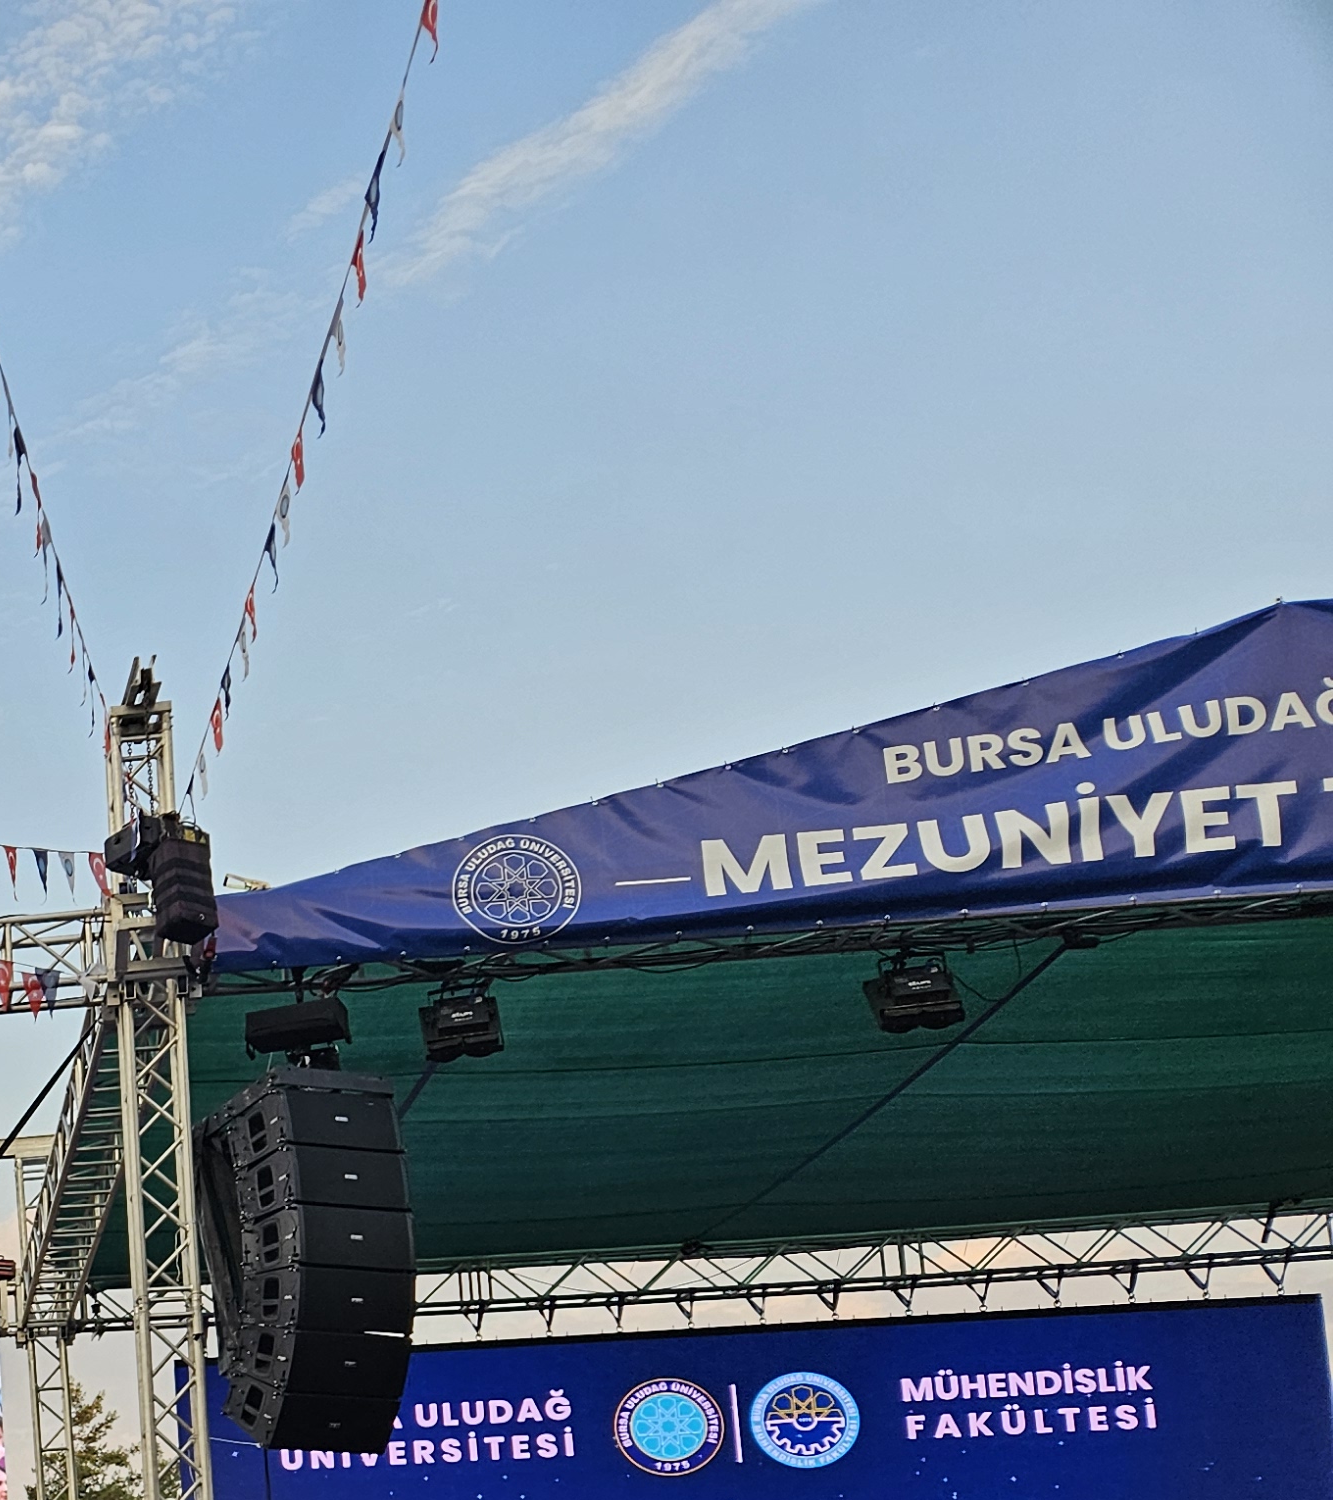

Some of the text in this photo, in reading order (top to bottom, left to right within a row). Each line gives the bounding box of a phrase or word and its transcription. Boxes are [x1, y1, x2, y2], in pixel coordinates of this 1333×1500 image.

[883, 722, 1092, 784] BURSA
[464, 838, 516, 872] ULUDAĞ
[701, 780, 1298, 897] MEZUNİYET
[457, 873, 473, 915] BURSA
[500, 926, 541, 940] 1975
[900, 1360, 1153, 1402] MÜHENDİSLİK
[414, 1388, 572, 1429] ULUDAĞ
[905, 1397, 1158, 1440] FAKÜLTESİ
[618, 1411, 633, 1448] BURSA
[654, 1460, 690, 1471] 1975
